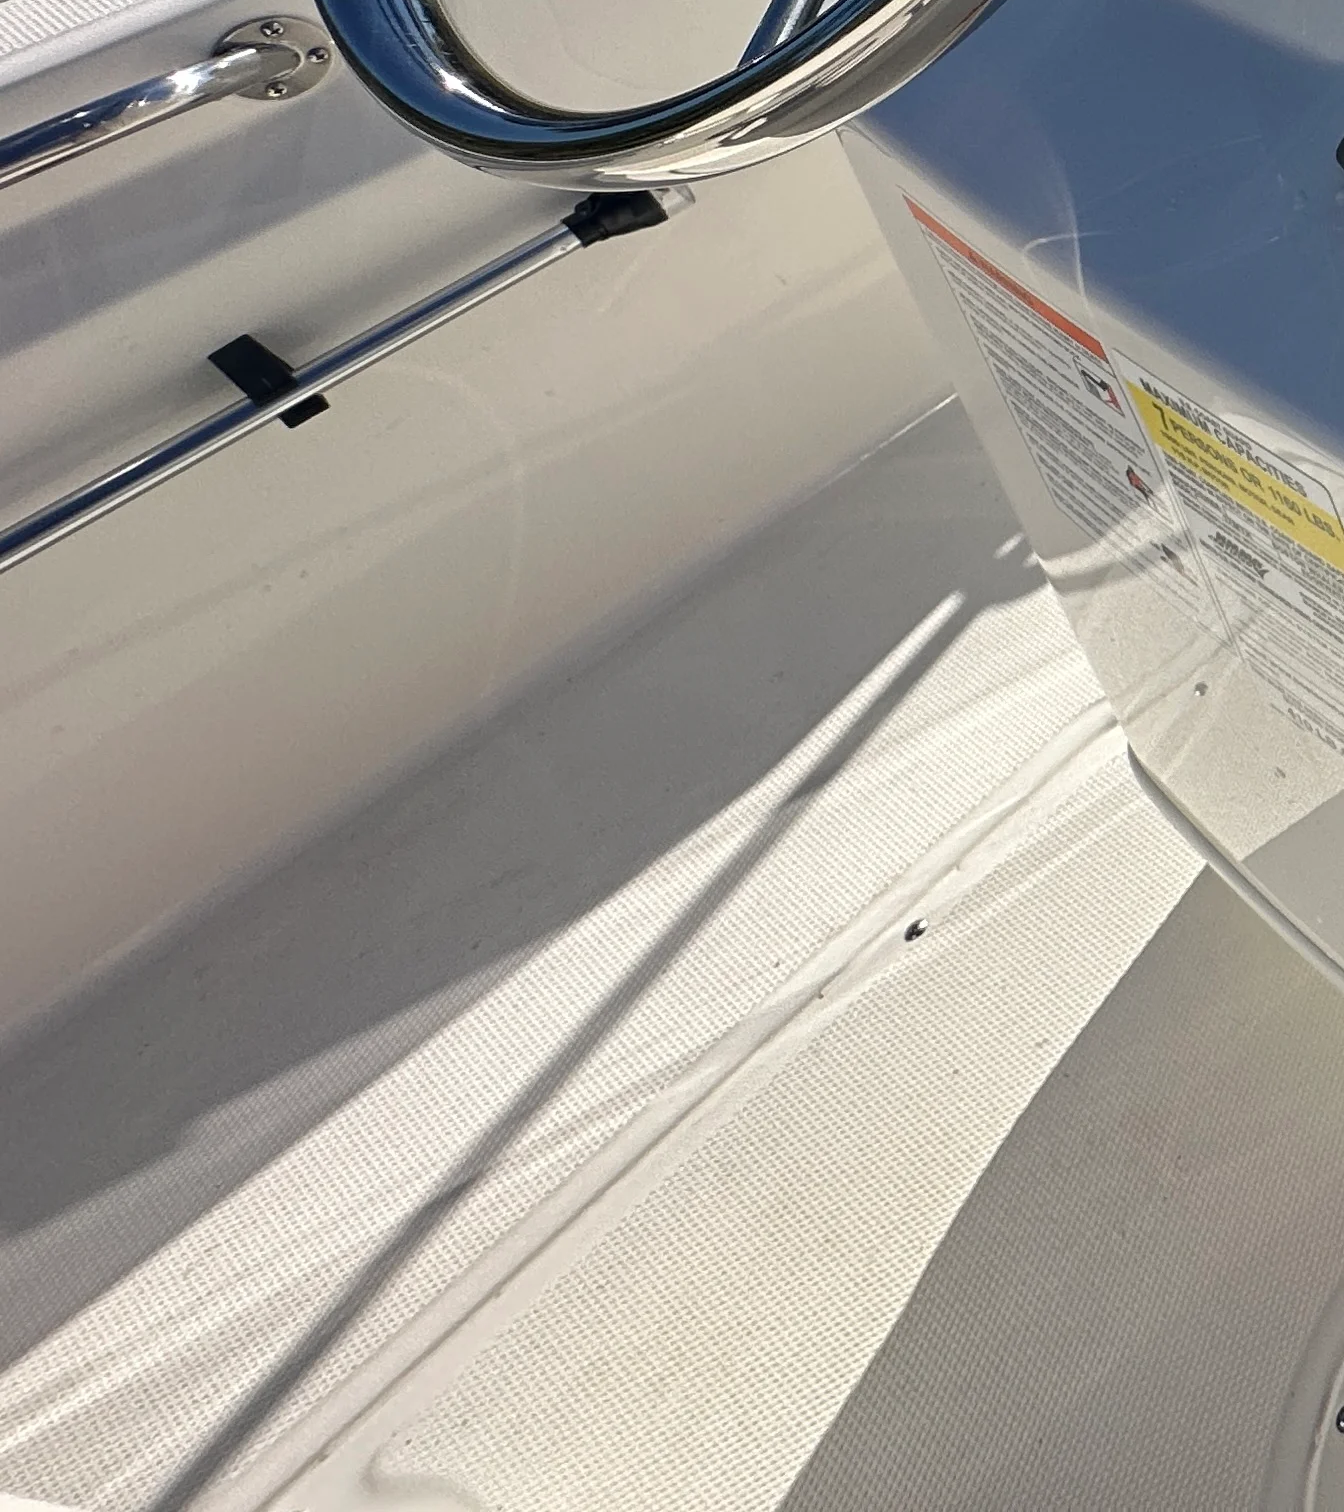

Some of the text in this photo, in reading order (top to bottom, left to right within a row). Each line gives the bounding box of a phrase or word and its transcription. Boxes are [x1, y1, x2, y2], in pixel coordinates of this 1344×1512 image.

[1137, 375, 1212, 436] MAXIMUM
[1211, 425, 1309, 500] CAPACITIES
[1150, 399, 1174, 435] 7
[1167, 415, 1240, 476] PERSONS
[1237, 463, 1265, 493] OR
